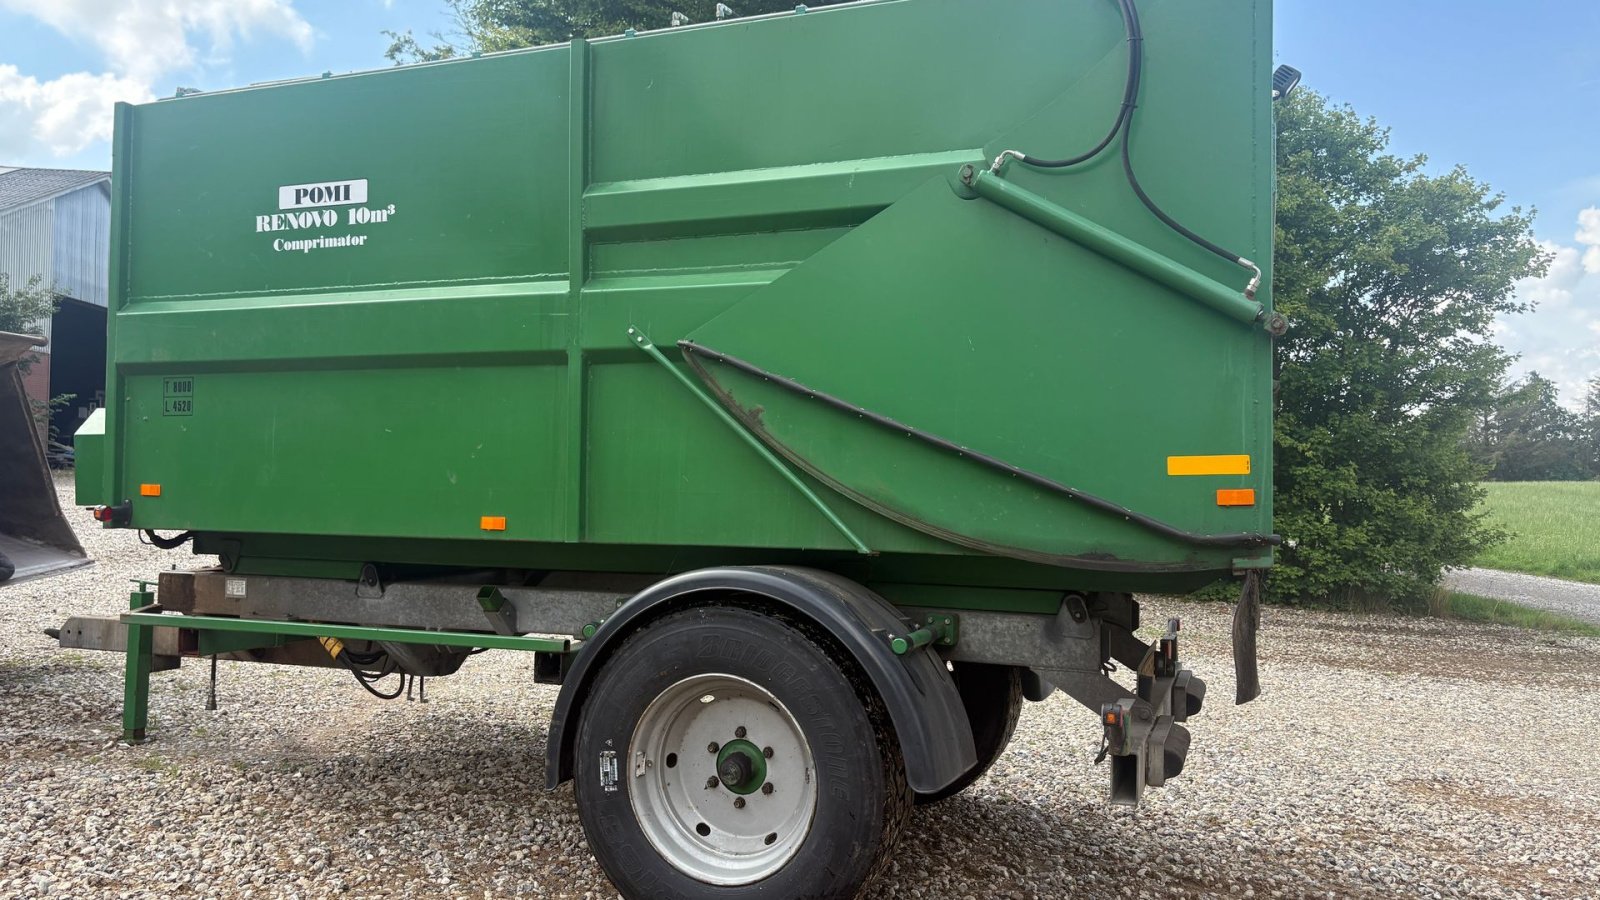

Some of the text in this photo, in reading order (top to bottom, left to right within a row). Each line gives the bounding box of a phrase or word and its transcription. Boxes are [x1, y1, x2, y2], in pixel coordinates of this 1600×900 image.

[294, 184, 352, 205] POMI
[255, 204, 396, 232] RENOVO 10m³
[273, 233, 368, 253] Comprimator
[165, 380, 170, 393] T
[165, 400, 192, 412] L 4520
